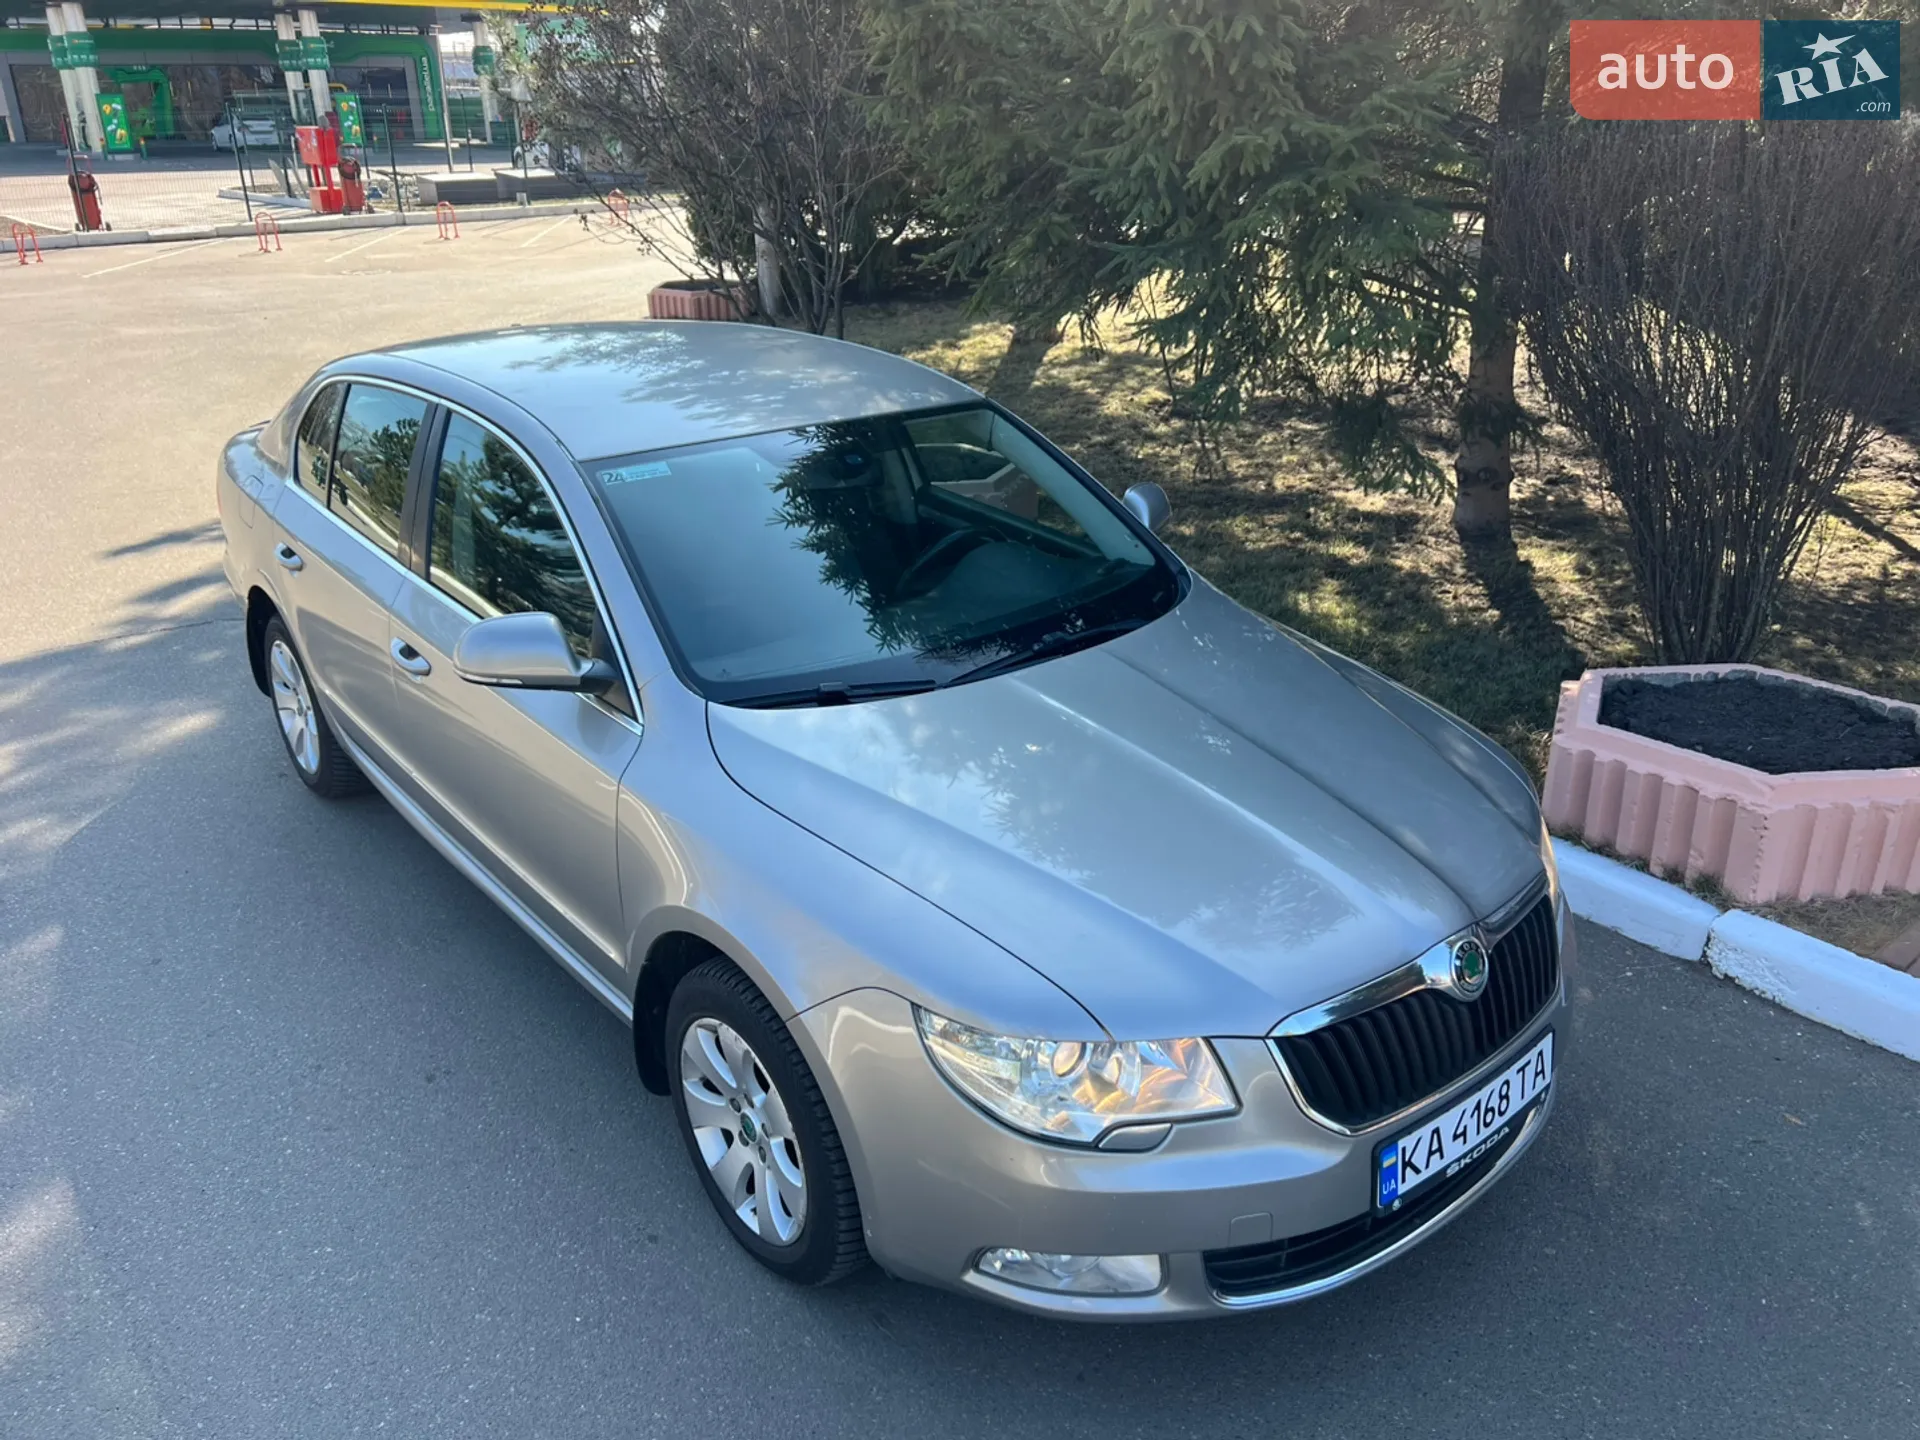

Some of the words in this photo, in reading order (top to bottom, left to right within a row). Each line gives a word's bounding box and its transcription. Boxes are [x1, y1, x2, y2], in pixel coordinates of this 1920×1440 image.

[1401, 1126, 1445, 1184] KA
[1452, 1080, 1511, 1146] 4168
[1516, 1050, 1546, 1100] TA
[1382, 1178, 1397, 1195] UA
